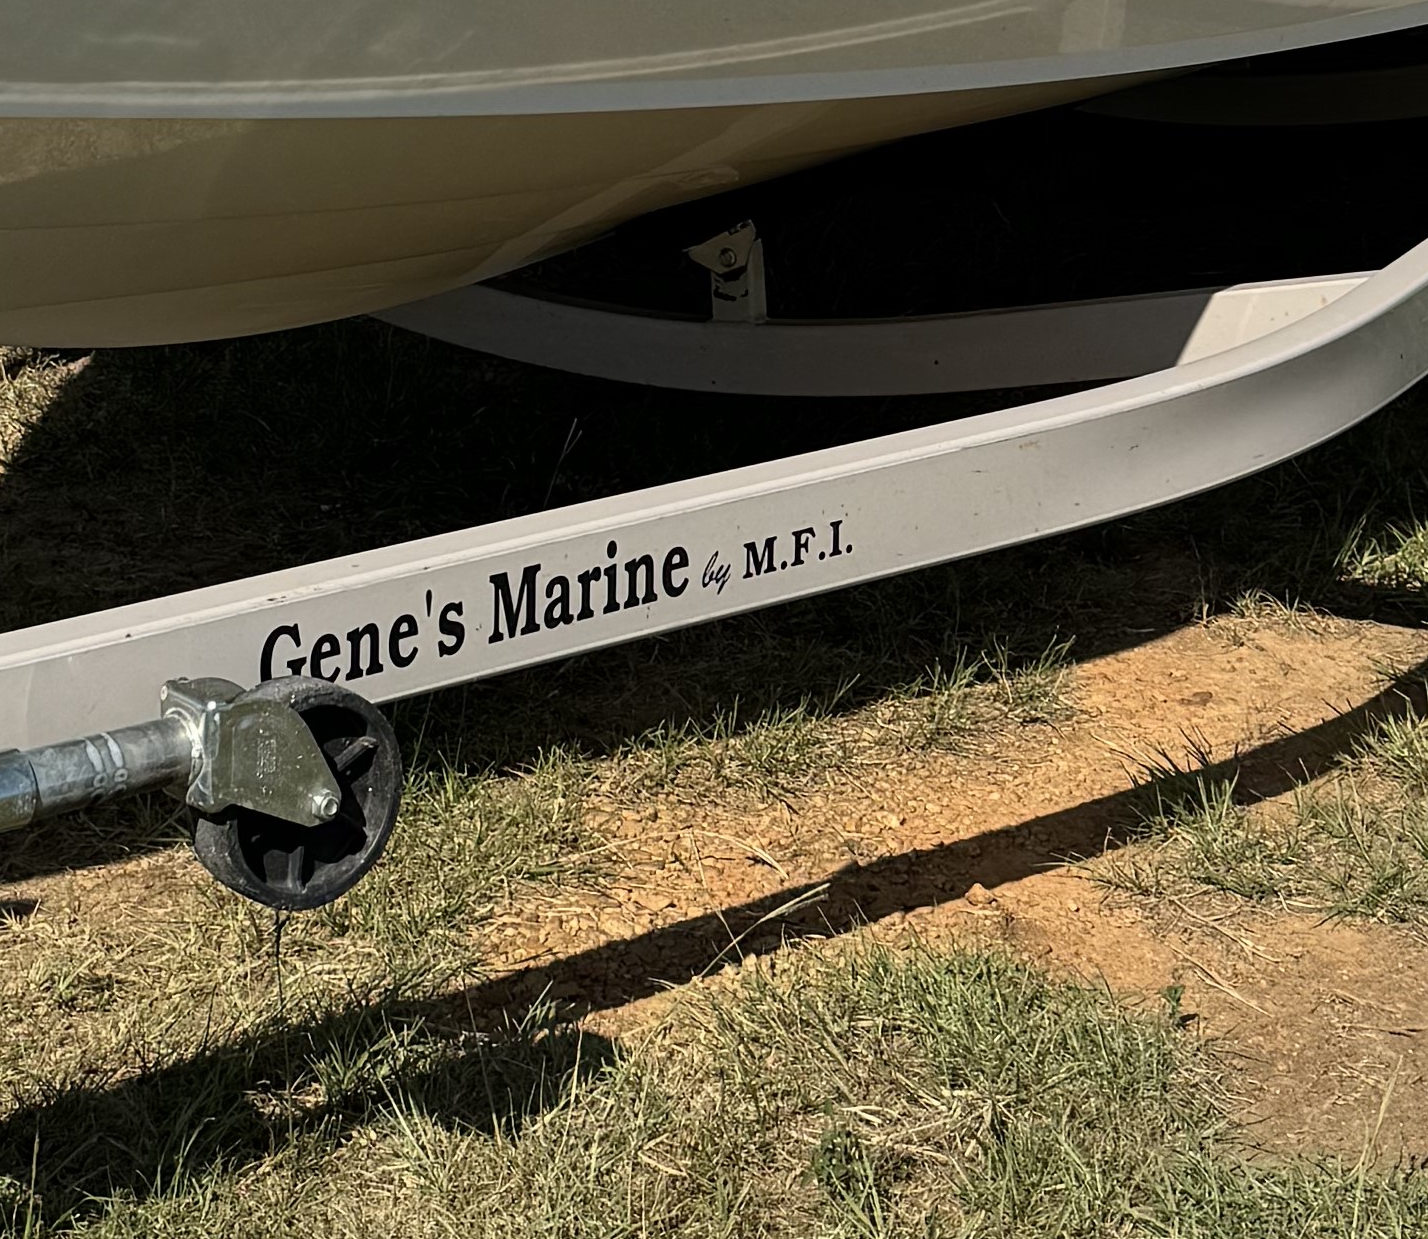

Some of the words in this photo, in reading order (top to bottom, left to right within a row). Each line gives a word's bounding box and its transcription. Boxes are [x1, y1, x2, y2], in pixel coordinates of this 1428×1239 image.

[259, 589, 465, 683] Gene's
[487, 540, 691, 645] Marine
[701, 550, 732, 595] by
[743, 520, 854, 580] M.F.I.
